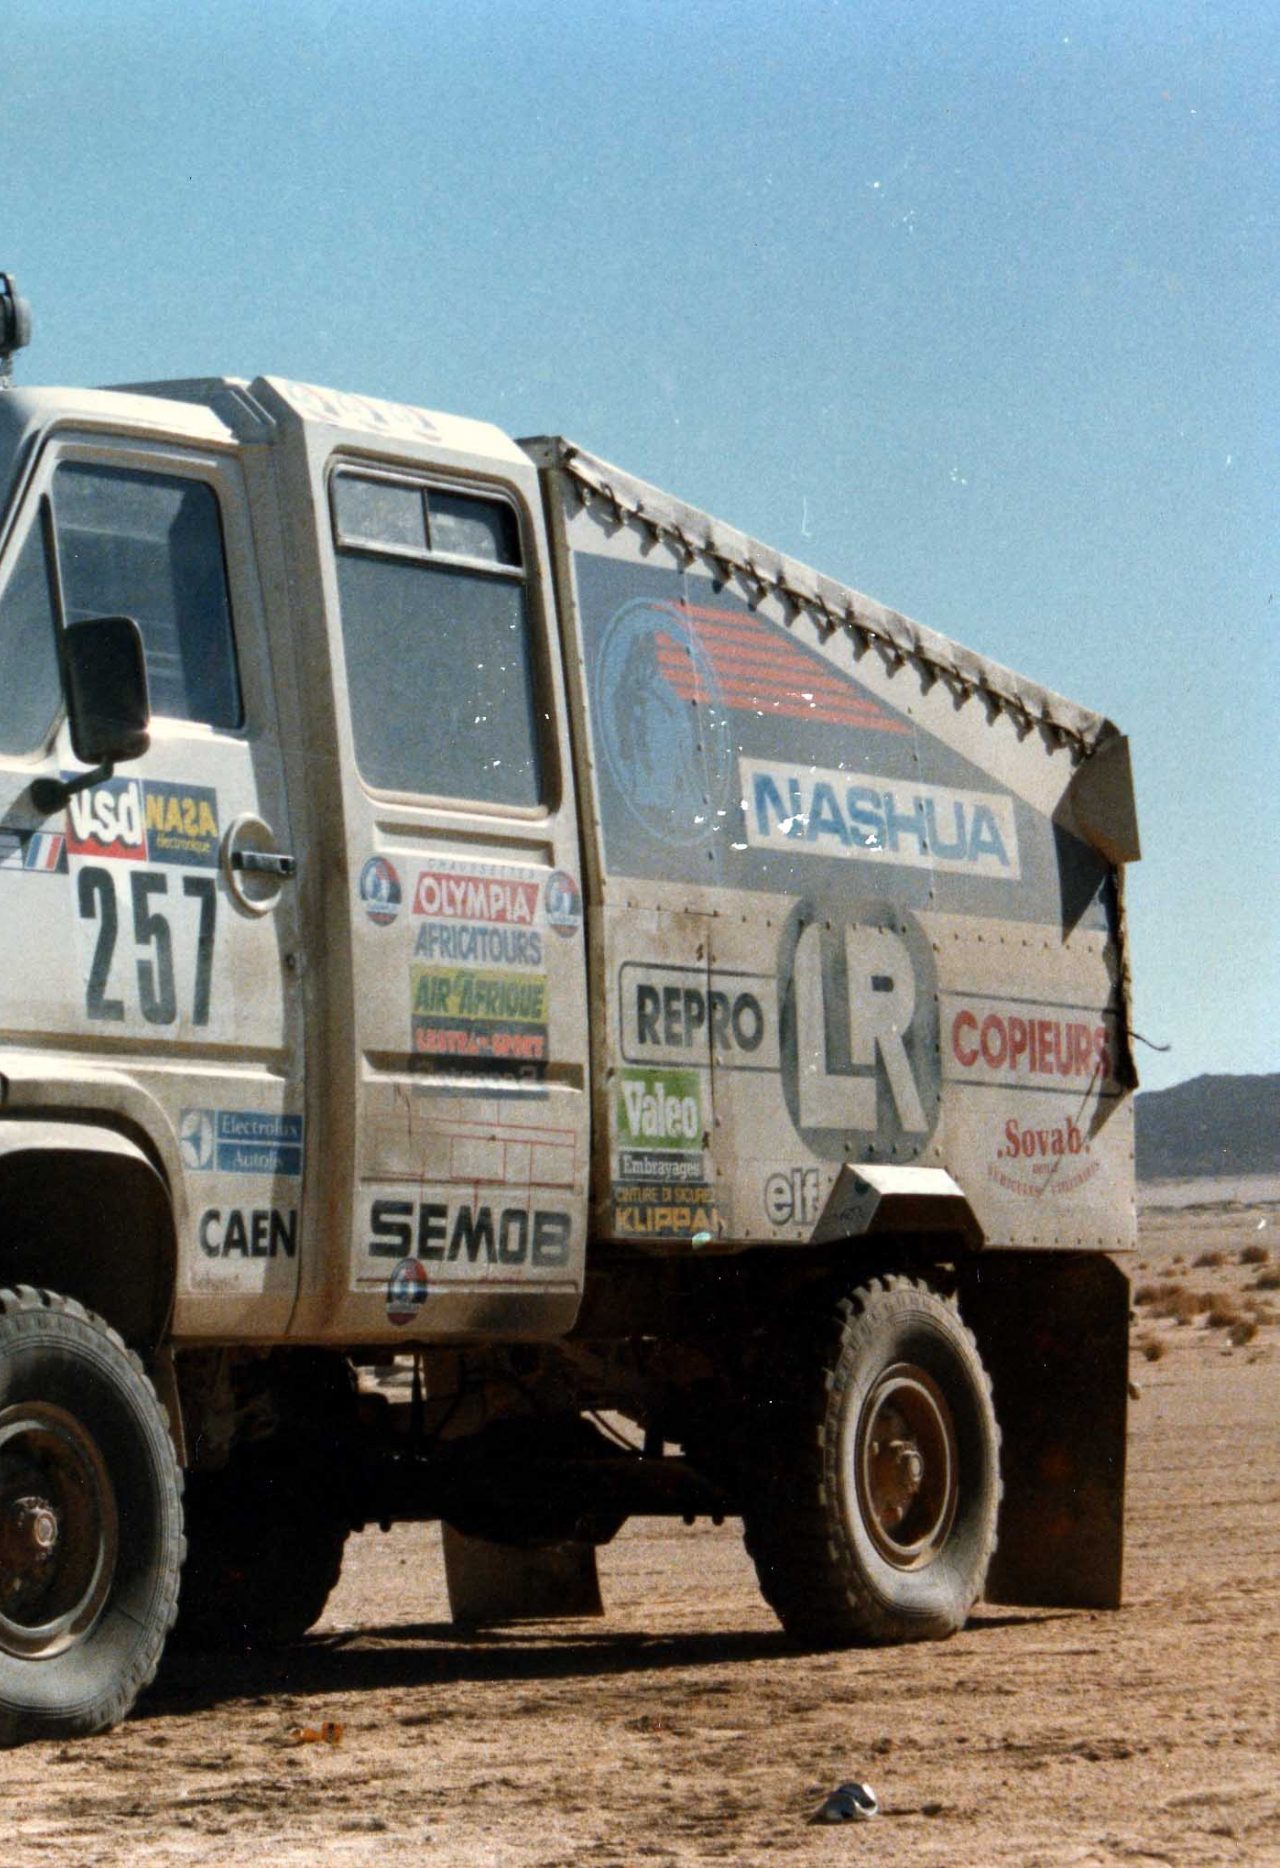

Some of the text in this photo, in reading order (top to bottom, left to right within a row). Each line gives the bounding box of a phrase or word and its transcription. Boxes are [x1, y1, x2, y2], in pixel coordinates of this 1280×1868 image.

[752, 772, 1011, 868] NASHUA
[420, 876, 532, 924] OLYMPIA
[77, 865, 217, 1027] 257
[415, 922, 542, 966] AFRICATOURS
[414, 975, 544, 1019] AIR AFRIQUE
[637, 922, 1112, 1133] REPRO LR COPIEURS
[222, 1115, 298, 1138] Electrolux
[622, 1080, 698, 1138] Valeo
[623, 1153, 700, 1182] Embrayages
[765, 1167, 820, 1227] elf
[199, 1208, 298, 1259] CAEN
[368, 1200, 572, 1267] SEMOB
